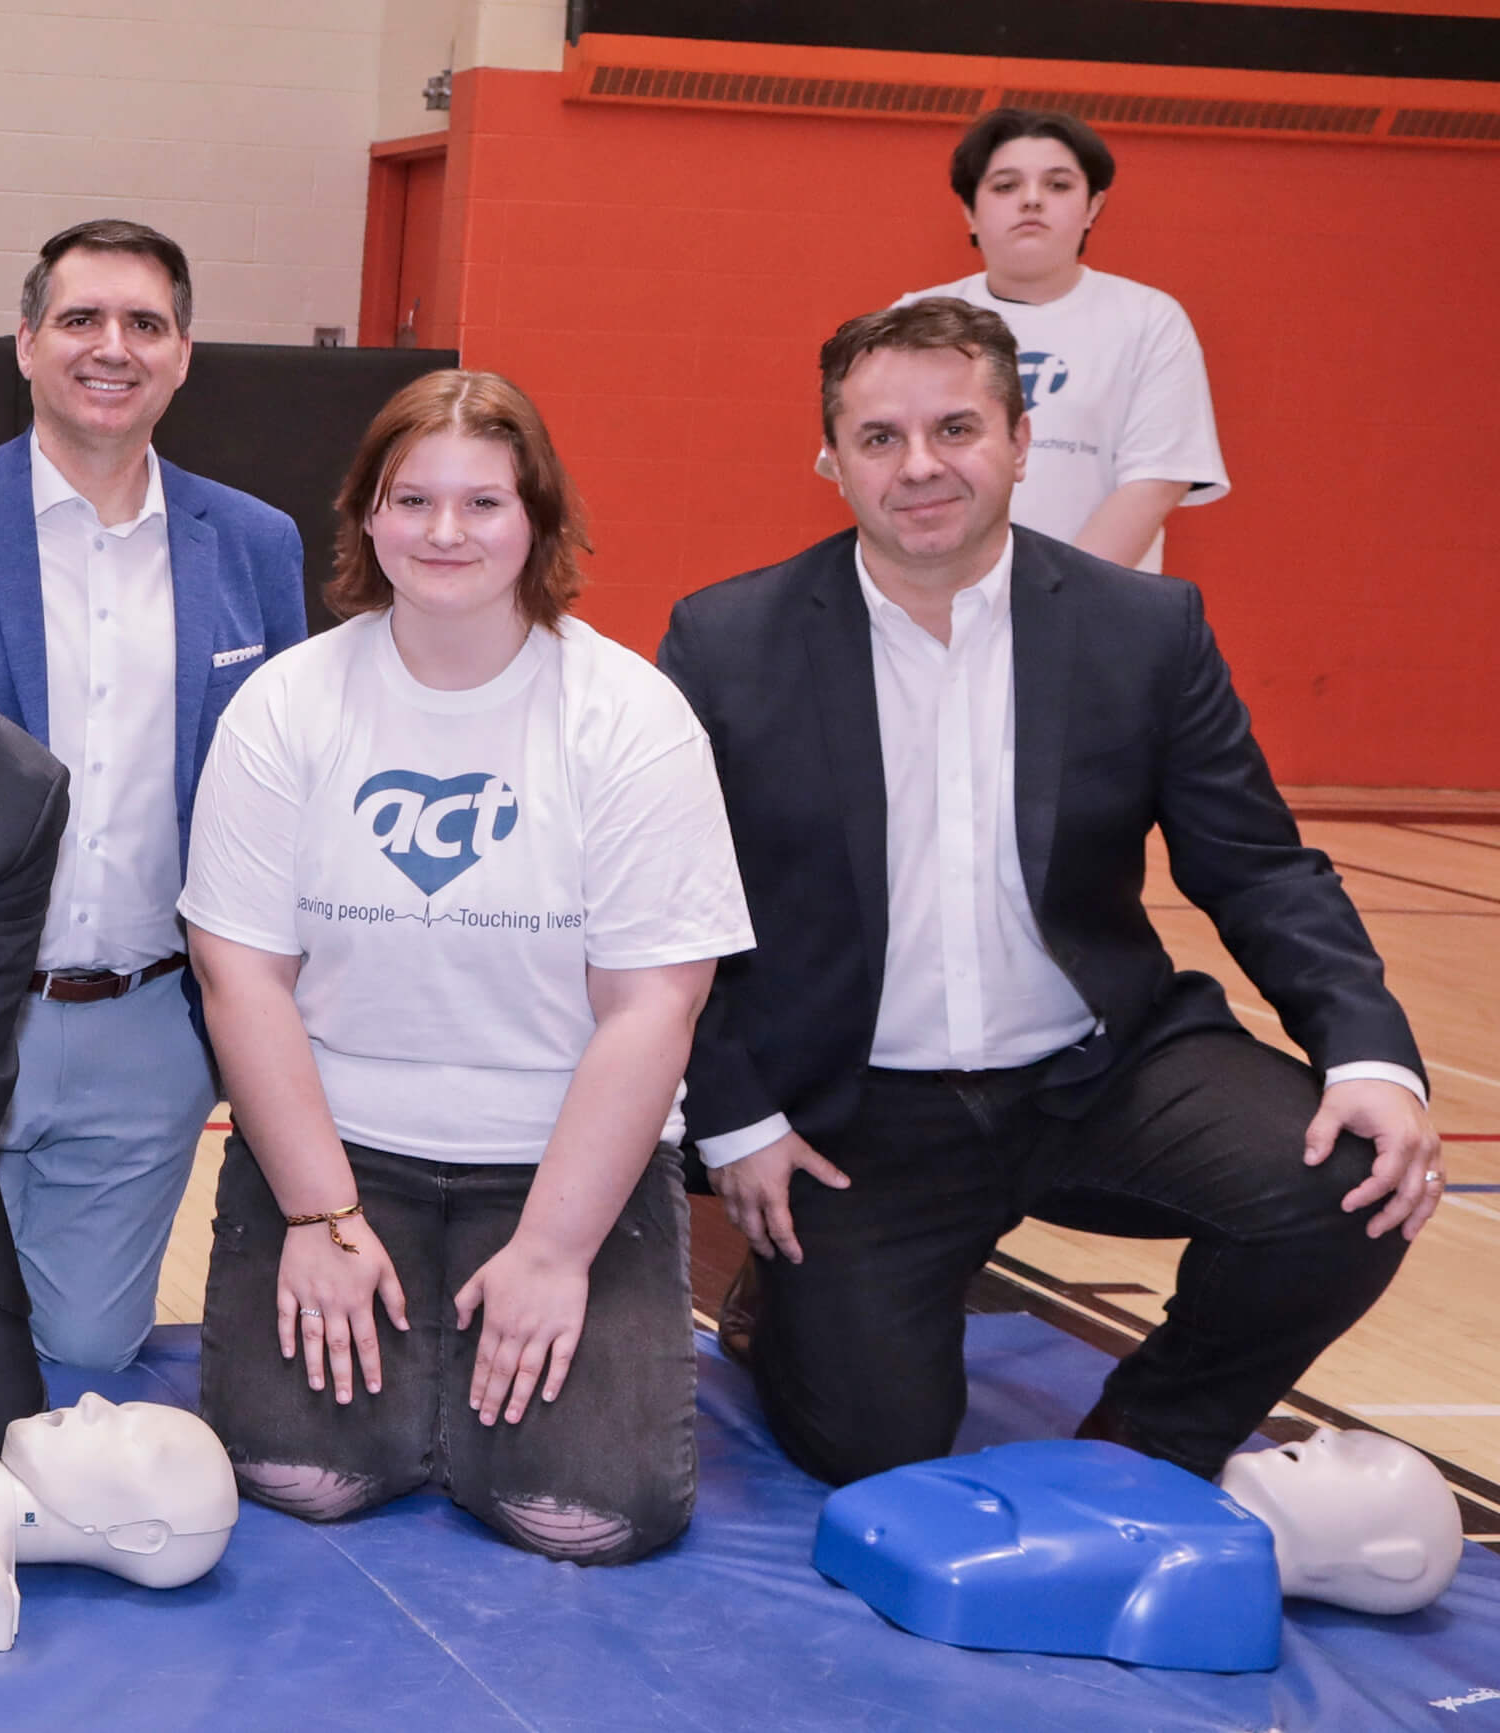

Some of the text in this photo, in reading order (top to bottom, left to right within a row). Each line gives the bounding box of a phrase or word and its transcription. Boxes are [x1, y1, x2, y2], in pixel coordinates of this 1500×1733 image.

[354, 776, 518, 859] act
[339, 904, 395, 924] people
[459, 908, 540, 933] Touching
[546, 911, 581, 929] lives
